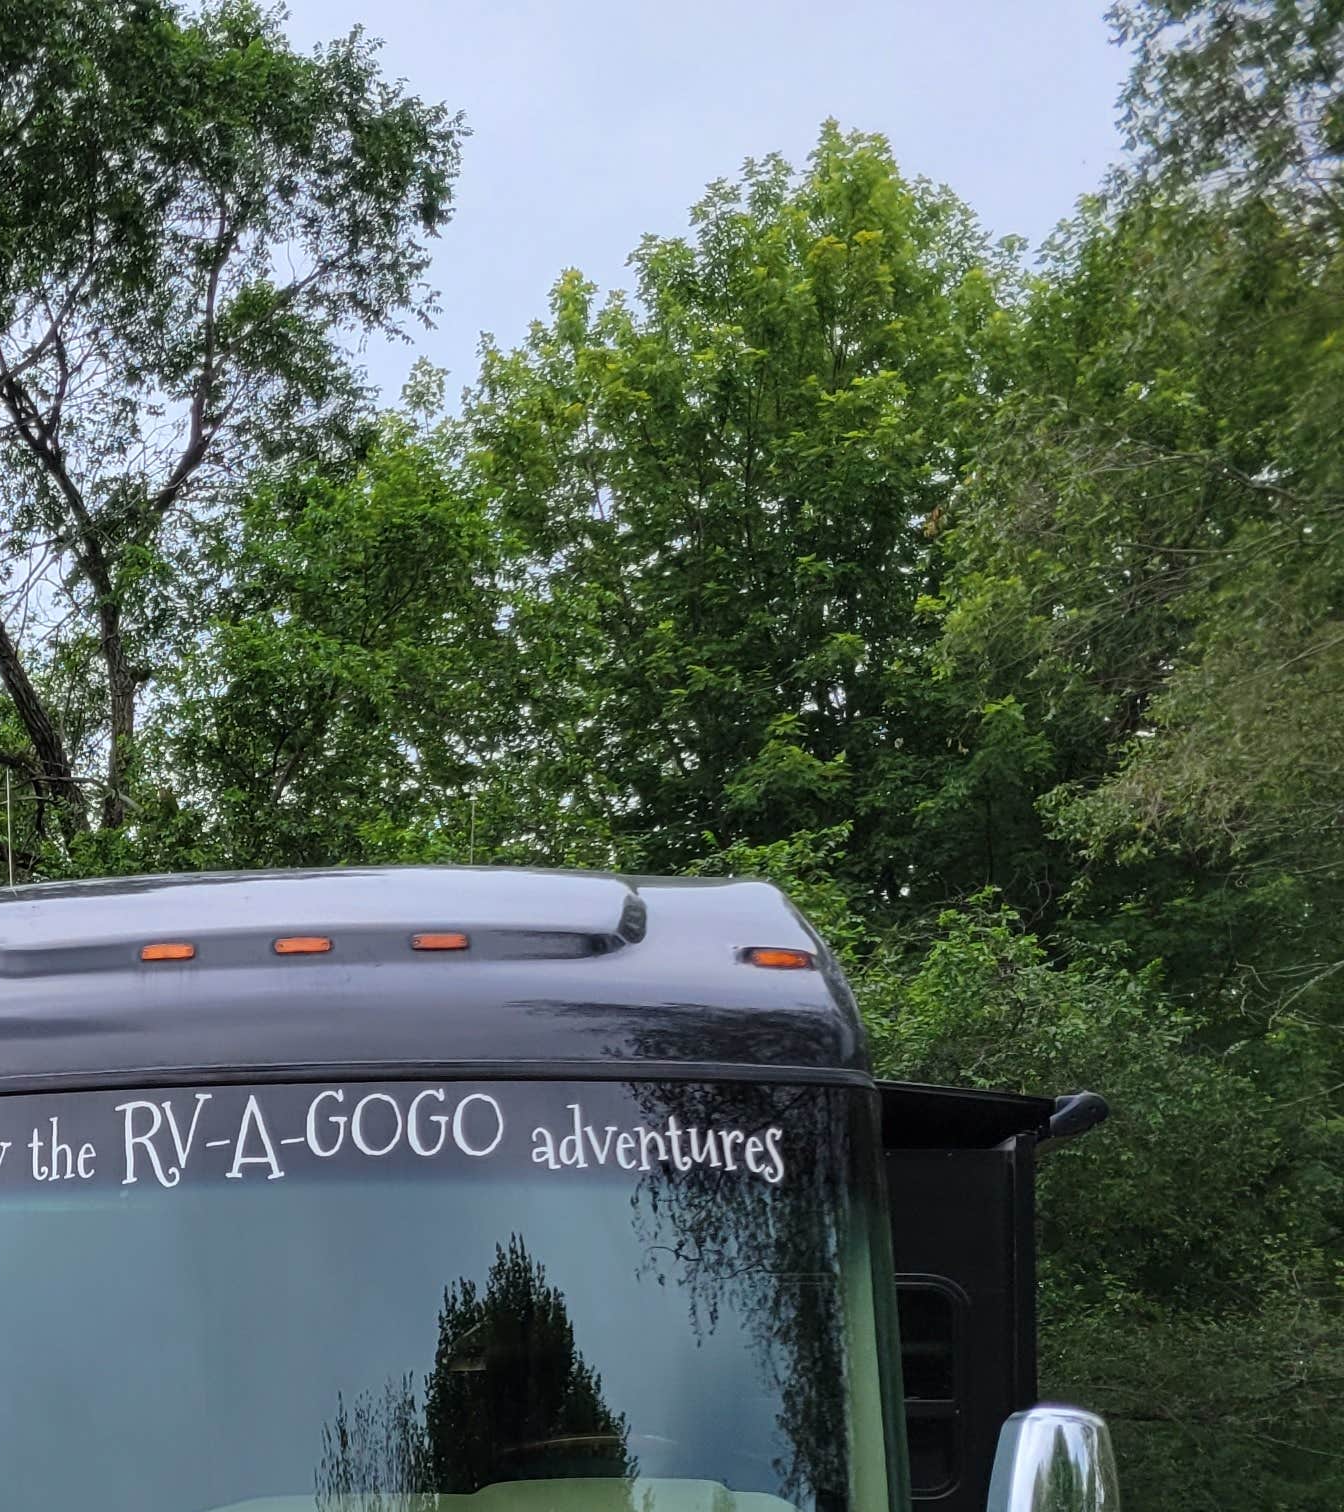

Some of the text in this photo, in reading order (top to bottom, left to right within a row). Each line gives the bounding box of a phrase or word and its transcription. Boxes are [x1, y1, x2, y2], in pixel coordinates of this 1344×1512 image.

[27, 1116, 97, 1182] the
[114, 1088, 504, 1188] RV-A-GOGO
[531, 1103, 785, 1184] adventures
